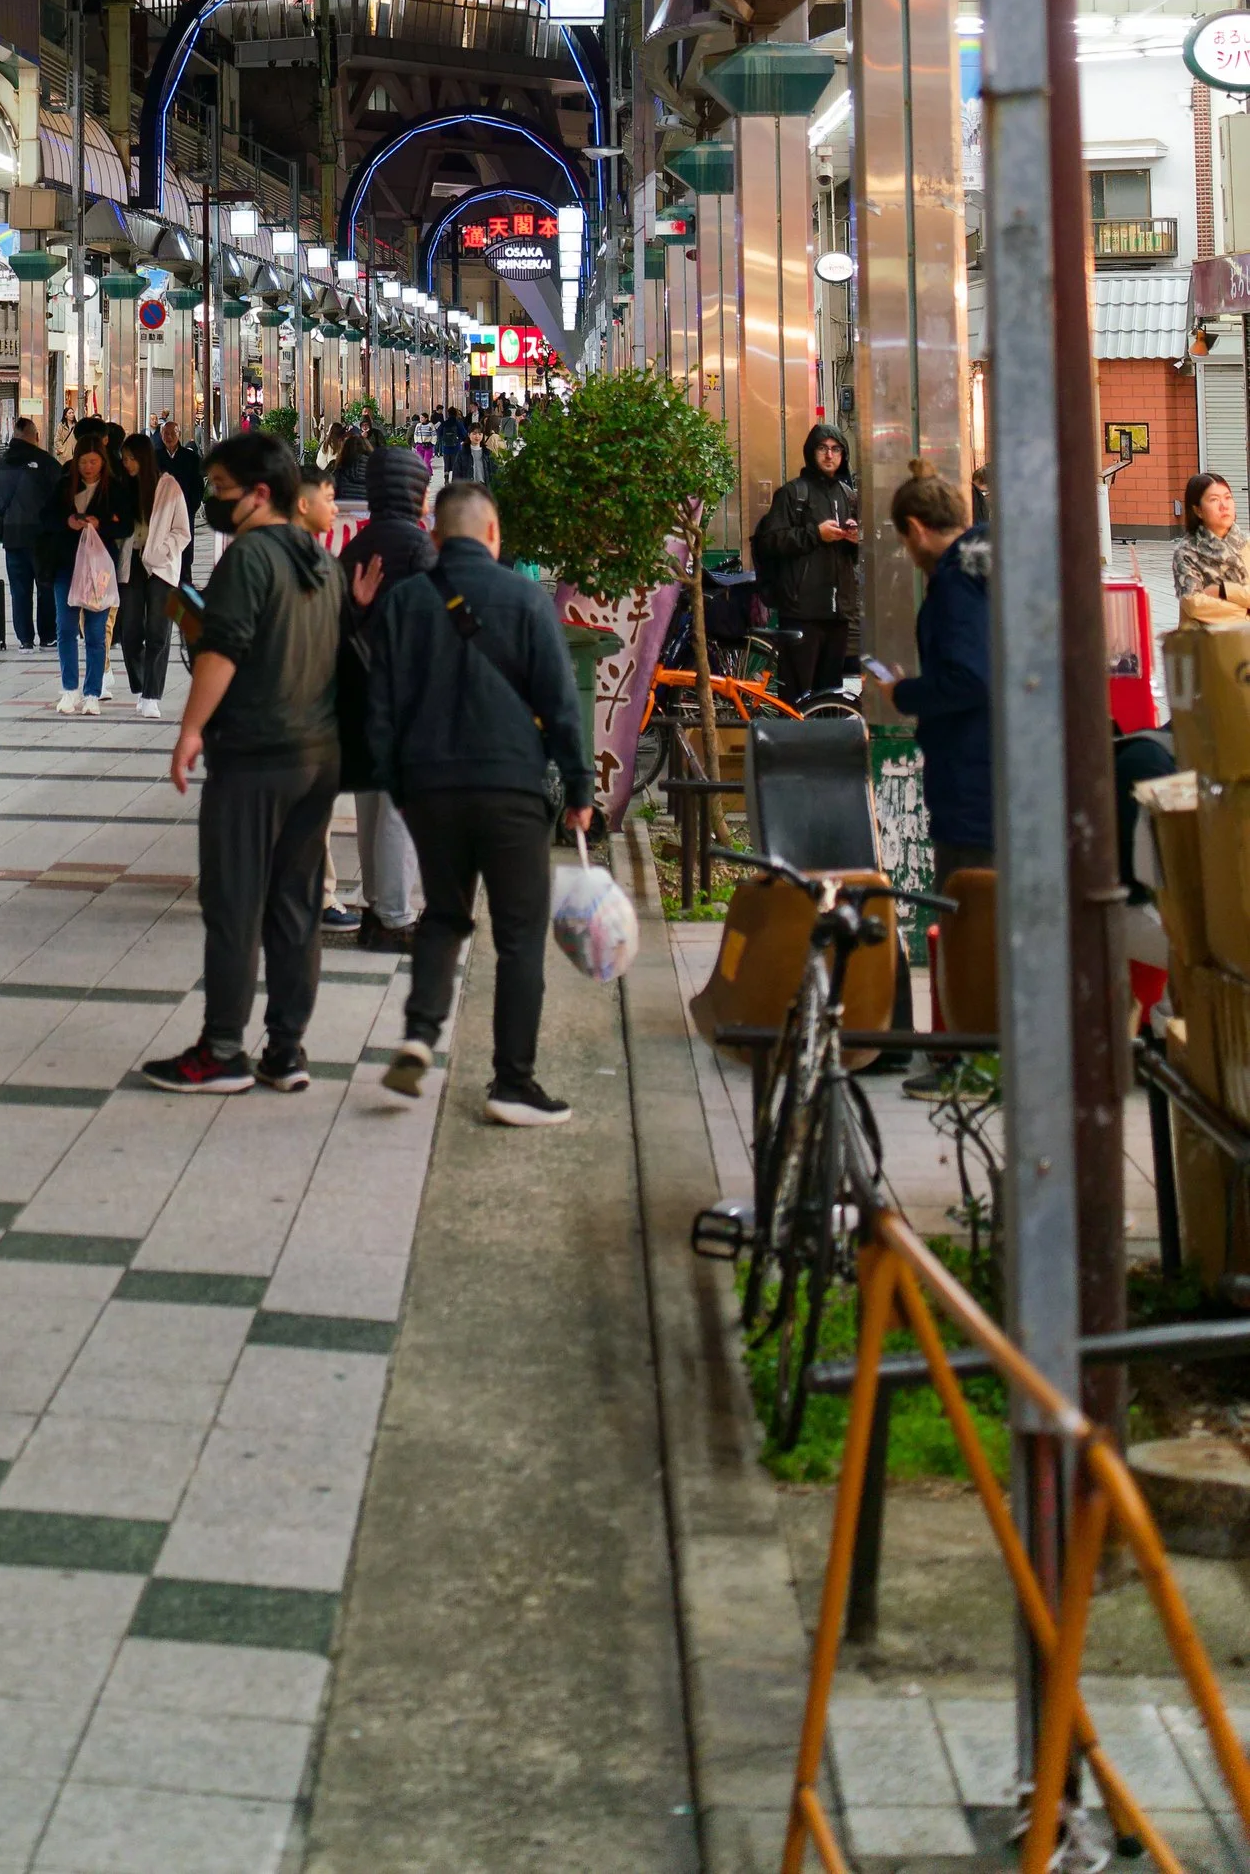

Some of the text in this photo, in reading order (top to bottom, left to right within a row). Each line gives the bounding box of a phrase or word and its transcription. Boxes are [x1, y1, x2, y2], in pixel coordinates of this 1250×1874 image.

[504, 246, 544, 258] OSAKA
[496, 258, 552, 270] SHINSEKAI
[140, 333, 164, 341] 自動車
